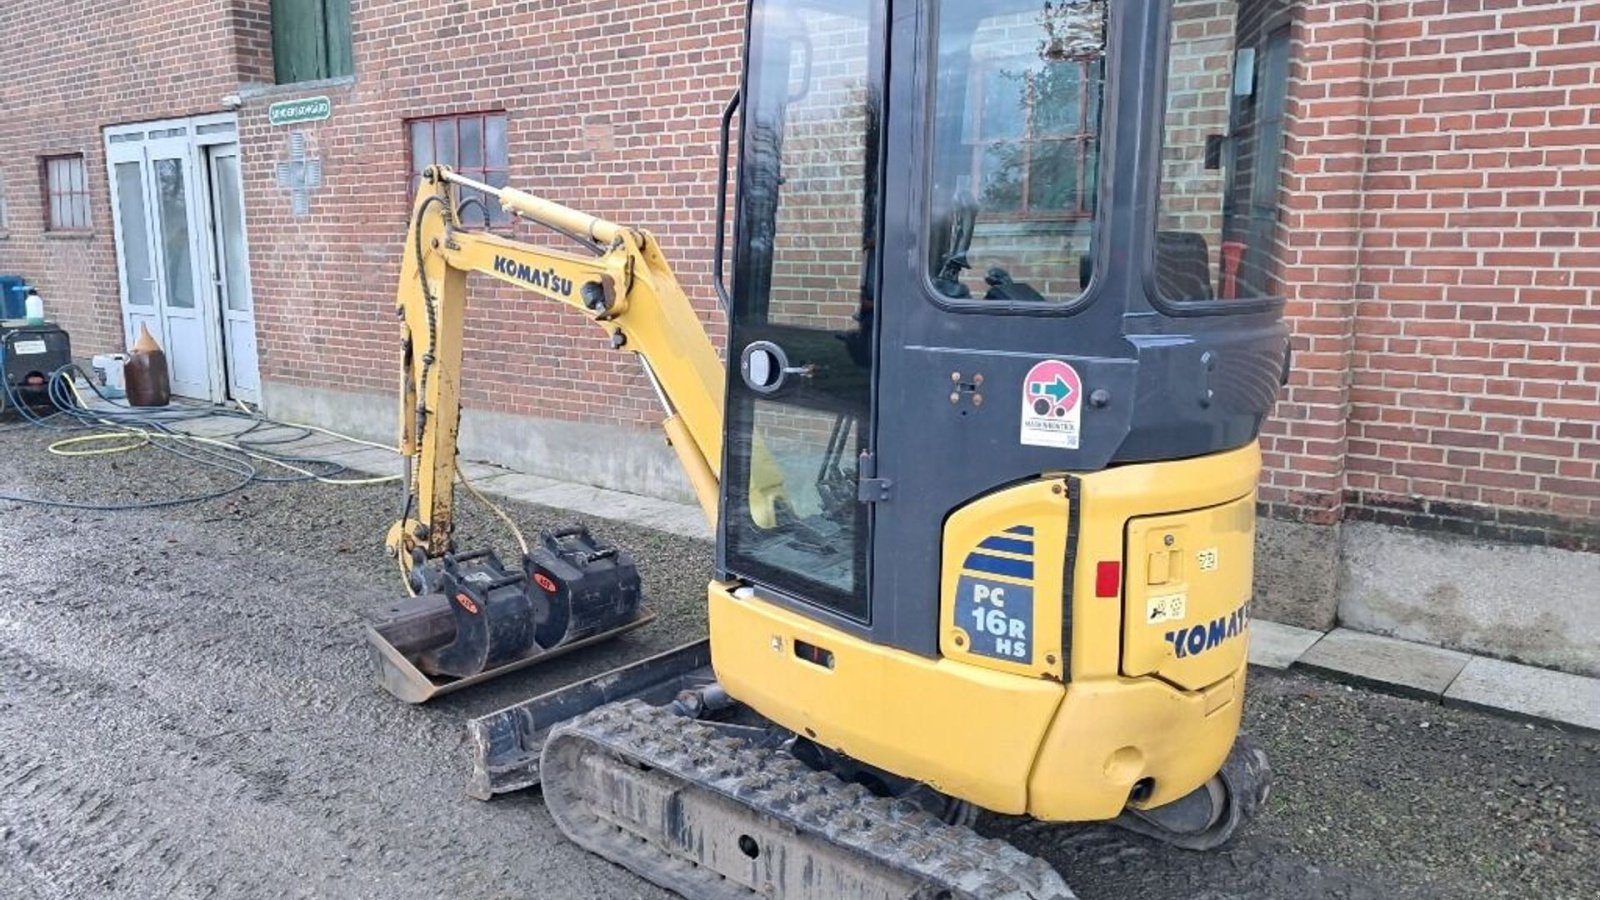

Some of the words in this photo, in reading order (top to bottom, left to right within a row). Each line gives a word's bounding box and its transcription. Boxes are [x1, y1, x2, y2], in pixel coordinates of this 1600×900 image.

[494, 254, 572, 296] KOMATSU
[973, 584, 1004, 607] PC
[971, 606, 1026, 640] 16R
[996, 637, 1026, 657] HS
